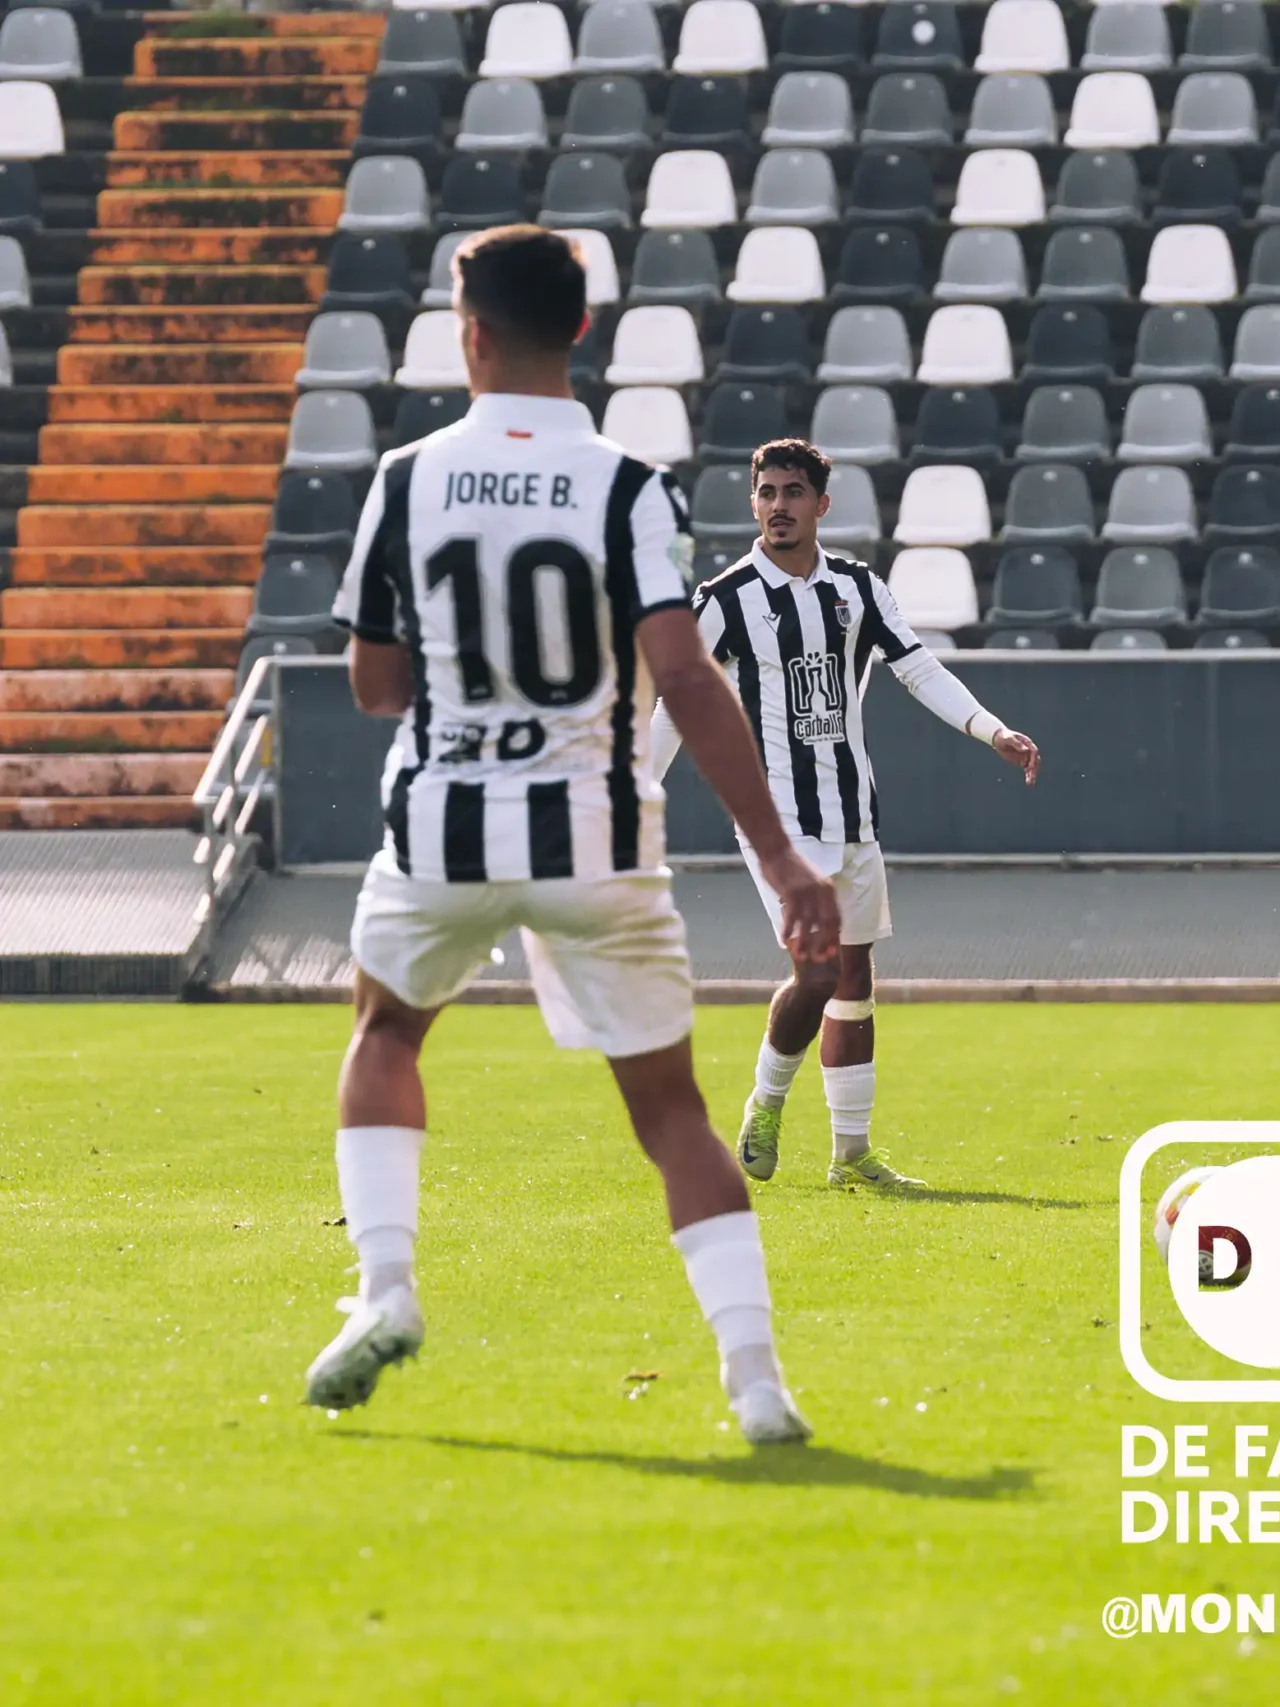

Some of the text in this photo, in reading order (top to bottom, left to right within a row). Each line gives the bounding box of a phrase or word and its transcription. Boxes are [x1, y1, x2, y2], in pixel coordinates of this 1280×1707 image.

[444, 471, 578, 511] JORGE B.
[425, 534, 601, 708] 10
